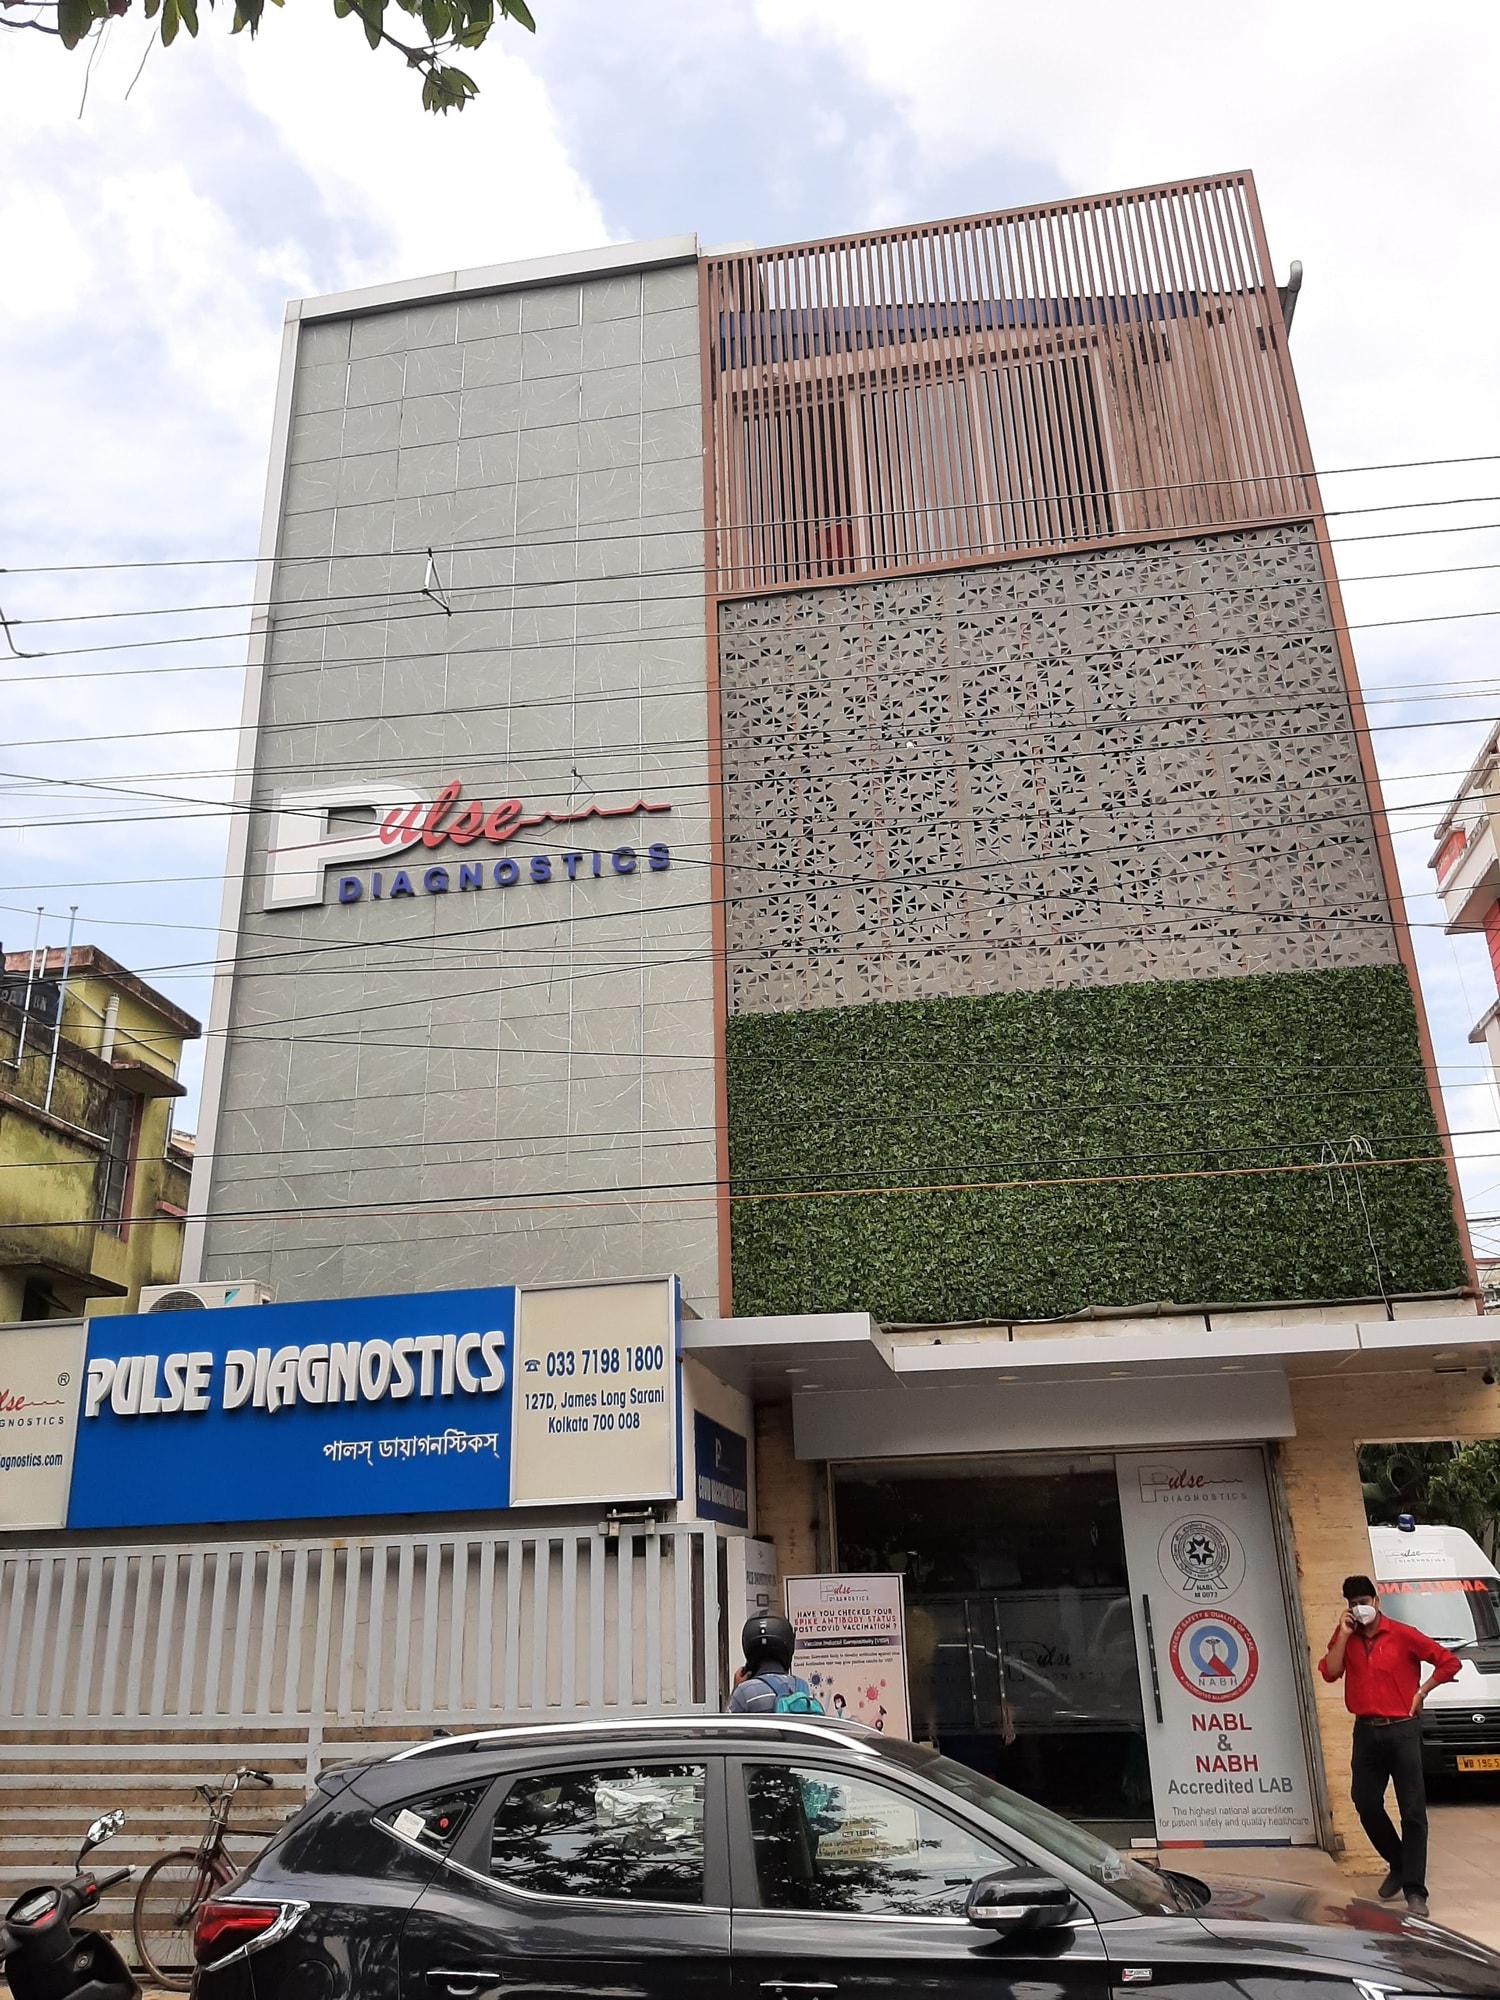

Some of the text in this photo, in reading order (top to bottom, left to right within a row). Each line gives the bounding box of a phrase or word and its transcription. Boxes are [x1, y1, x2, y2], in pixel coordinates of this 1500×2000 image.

[263, 778, 523, 912] Pulse
[338, 842, 671, 904] DIAGNOSTICS
[546, 1344, 664, 1377] 033 7198 1800
[85, 1330, 505, 1417] PULSE DIAGNOSTICS
[525, 1386, 664, 1411] 127D, James Long Sarani
[548, 1412, 640, 1434] Kolkata 700 008
[323, 1428, 500, 1467] পালস্ ডায়াগনস্টিকস্
[1138, 1465, 1205, 1503] Pulse
[1163, 1492, 1248, 1503] DIAGNOSTICS
[820, 1581, 851, 1602] Pulse
[794, 1615, 896, 1626] SPIKE ANTIBODY STATUS
[797, 1610, 816, 1618] HAVE
[820, 1609, 835, 1617] YOU
[838, 1608, 871, 1616] CHECKED
[794, 1625, 813, 1633] POST
[843, 1623, 891, 1631] VACCINATION
[1198, 1678, 1237, 1687] NABH
[1191, 1713, 1252, 1731] NABL
[1217, 1734, 1233, 1751] &
[1196, 1755, 1259, 1773] NABH
[1168, 1777, 1293, 1795] Accredited LAB
[1172, 1806, 1187, 1815] The
[1189, 1806, 1217, 1818] highest
[1219, 1805, 1249, 1815] national
[1159, 1816, 1310, 1829] for patient safety and quality healthcare
